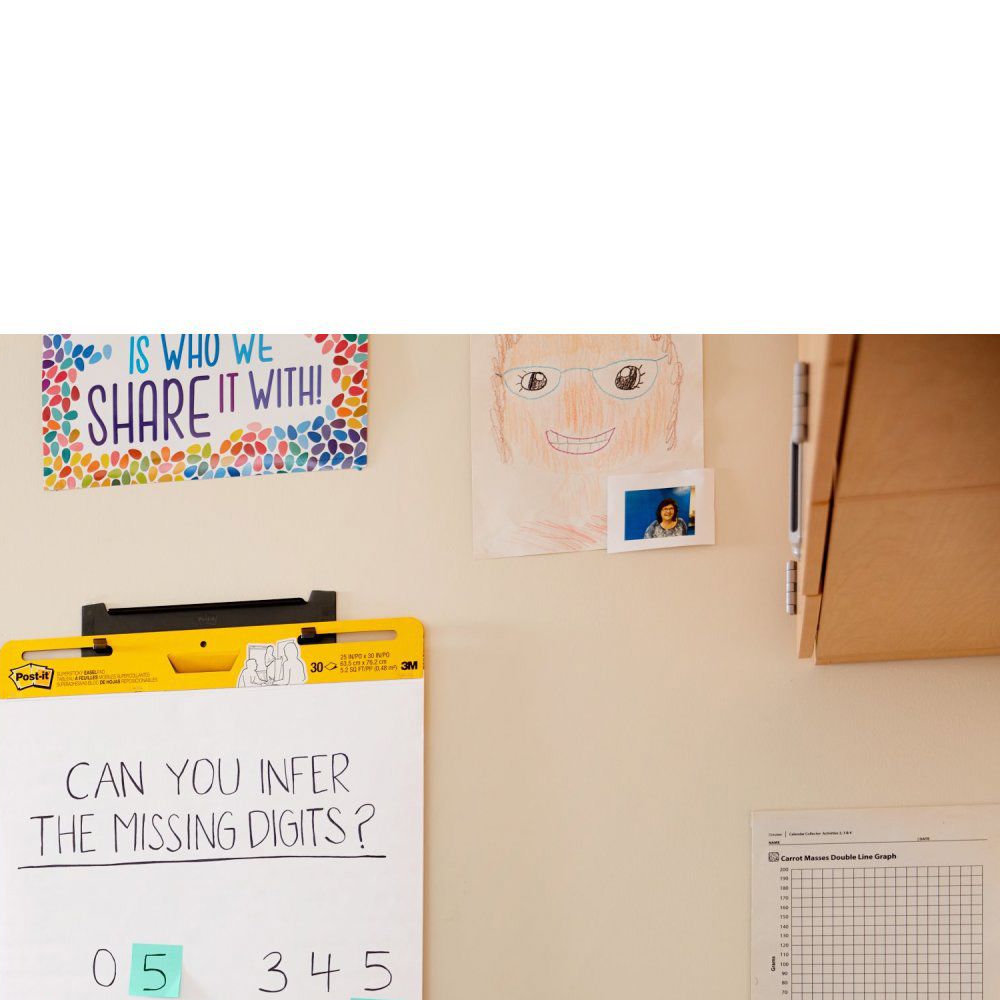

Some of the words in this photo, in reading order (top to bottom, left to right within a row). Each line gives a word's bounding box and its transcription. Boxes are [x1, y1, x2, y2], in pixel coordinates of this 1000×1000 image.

[128, 335, 150, 375] IS
[160, 334, 220, 371] WHO
[232, 334, 273, 365] WE
[88, 375, 211, 447] SHARE
[219, 372, 239, 413] IT
[249, 365, 323, 411] WITH!
[15, 670, 50, 682] Post-it
[310, 662, 324, 673] 30
[400, 660, 418, 671] 3M
[66, 760, 145, 801] CAN
[165, 758, 241, 796] YOU
[260, 752, 350, 796] INFER
[29, 813, 96, 857] THE
[114, 811, 236, 854] MISSING
[92, 948, 117, 988] 0
[143, 953, 167, 992] 5
